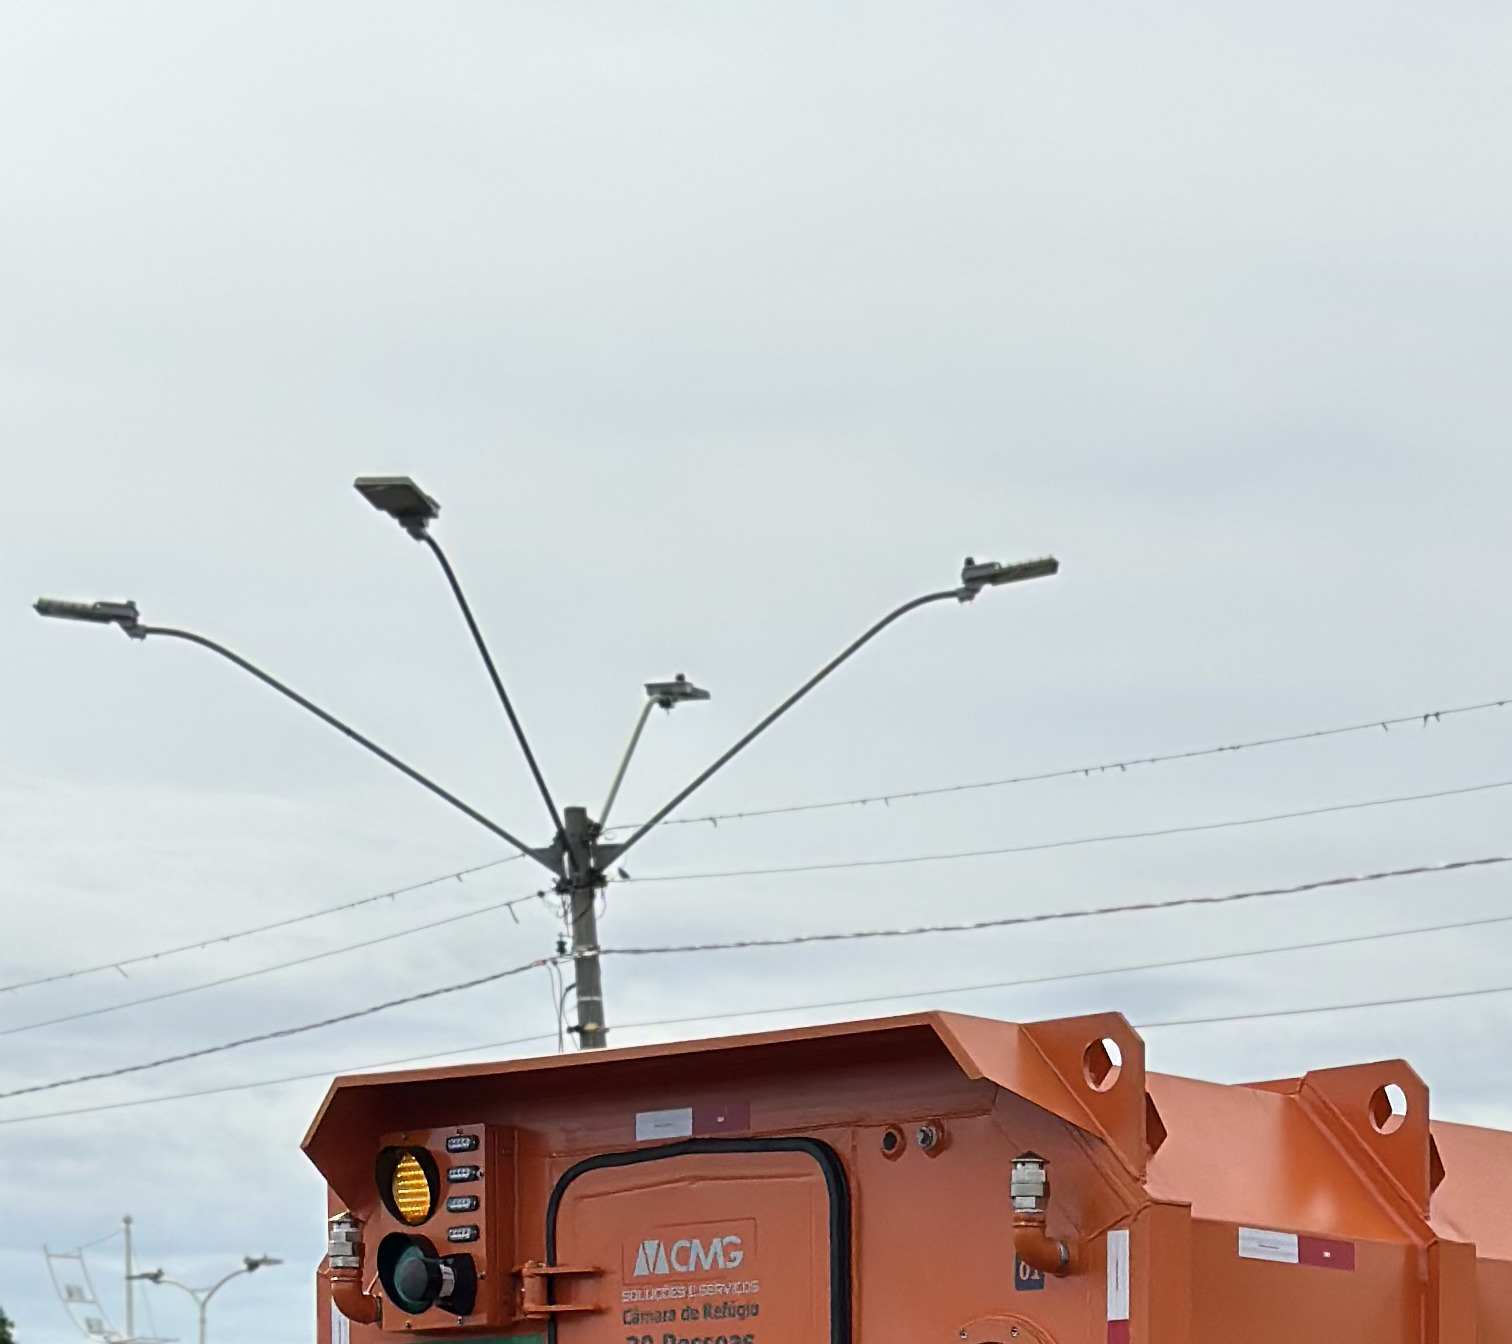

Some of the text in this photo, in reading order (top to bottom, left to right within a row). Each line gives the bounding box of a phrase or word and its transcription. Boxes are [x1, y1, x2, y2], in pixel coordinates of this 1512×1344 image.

[670, 1235, 744, 1273] CMG
[623, 1300, 760, 1325] Câmara de Refúgio
